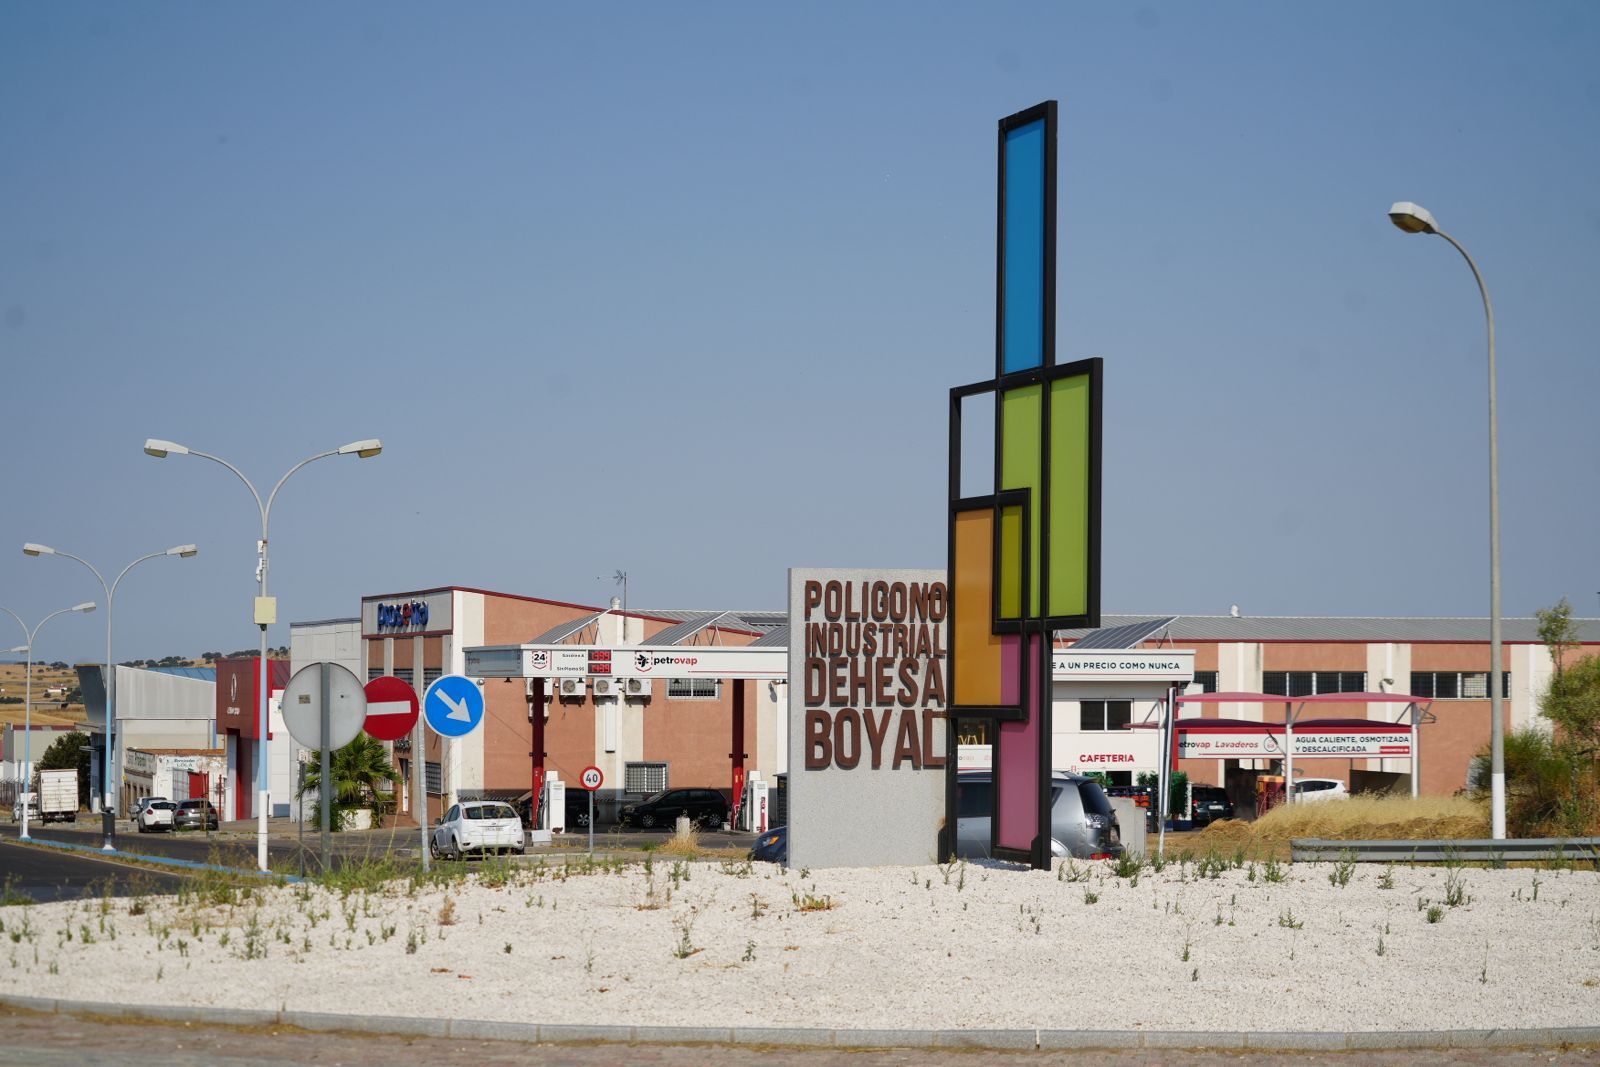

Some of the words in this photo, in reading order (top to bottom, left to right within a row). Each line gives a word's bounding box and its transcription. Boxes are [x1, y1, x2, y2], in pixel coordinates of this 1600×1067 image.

[804, 580, 947, 622] POLIGONO
[805, 622, 947, 659] INDUSTRIAL
[533, 653, 546, 661] 24
[654, 656, 698, 666] petrovap
[1060, 662, 1066, 670] A
[1068, 662, 1081, 670] UN
[1083, 662, 1117, 670] PRECIO
[1119, 662, 1146, 670] COMO
[1148, 662, 1180, 670] NUNCA
[804, 657, 946, 707] DEHESA
[805, 708, 947, 770] BOYAL
[1318, 736, 1358, 744] CALIENTE,
[1178, 741, 1211, 750] etrovap
[1079, 754, 1135, 763] CAFETERIA
[585, 773, 598, 783] 40
